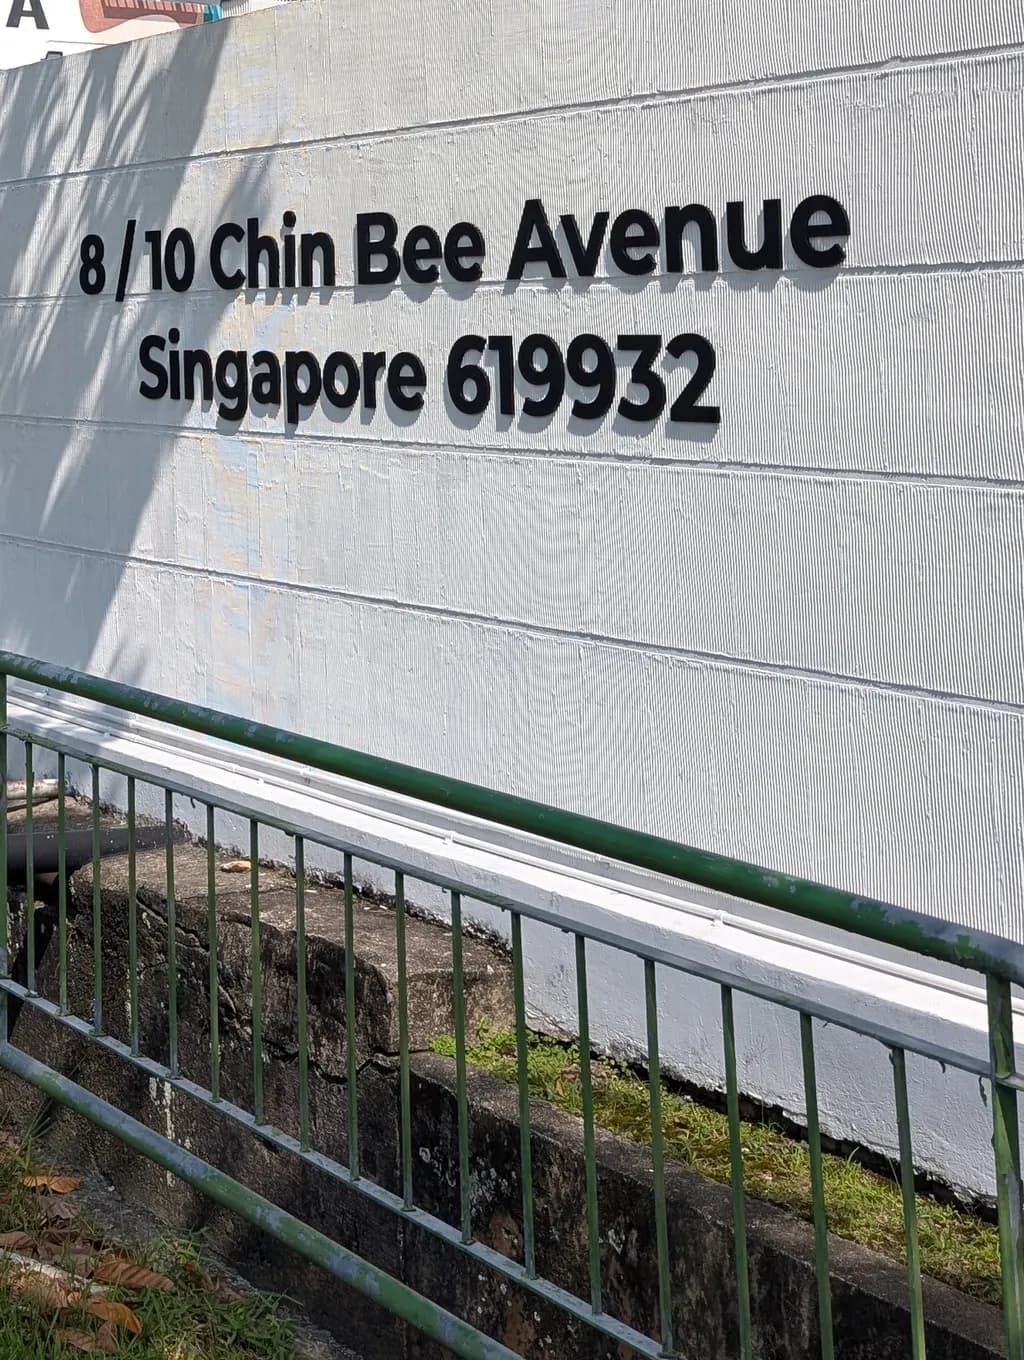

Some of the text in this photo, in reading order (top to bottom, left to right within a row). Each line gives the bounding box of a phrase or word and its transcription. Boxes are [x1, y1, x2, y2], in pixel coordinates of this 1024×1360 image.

[209, 210, 336, 291] Chin
[355, 211, 486, 285] Bee
[506, 193, 852, 281] Avenue
[138, 328, 721, 425] Singapore 619932
